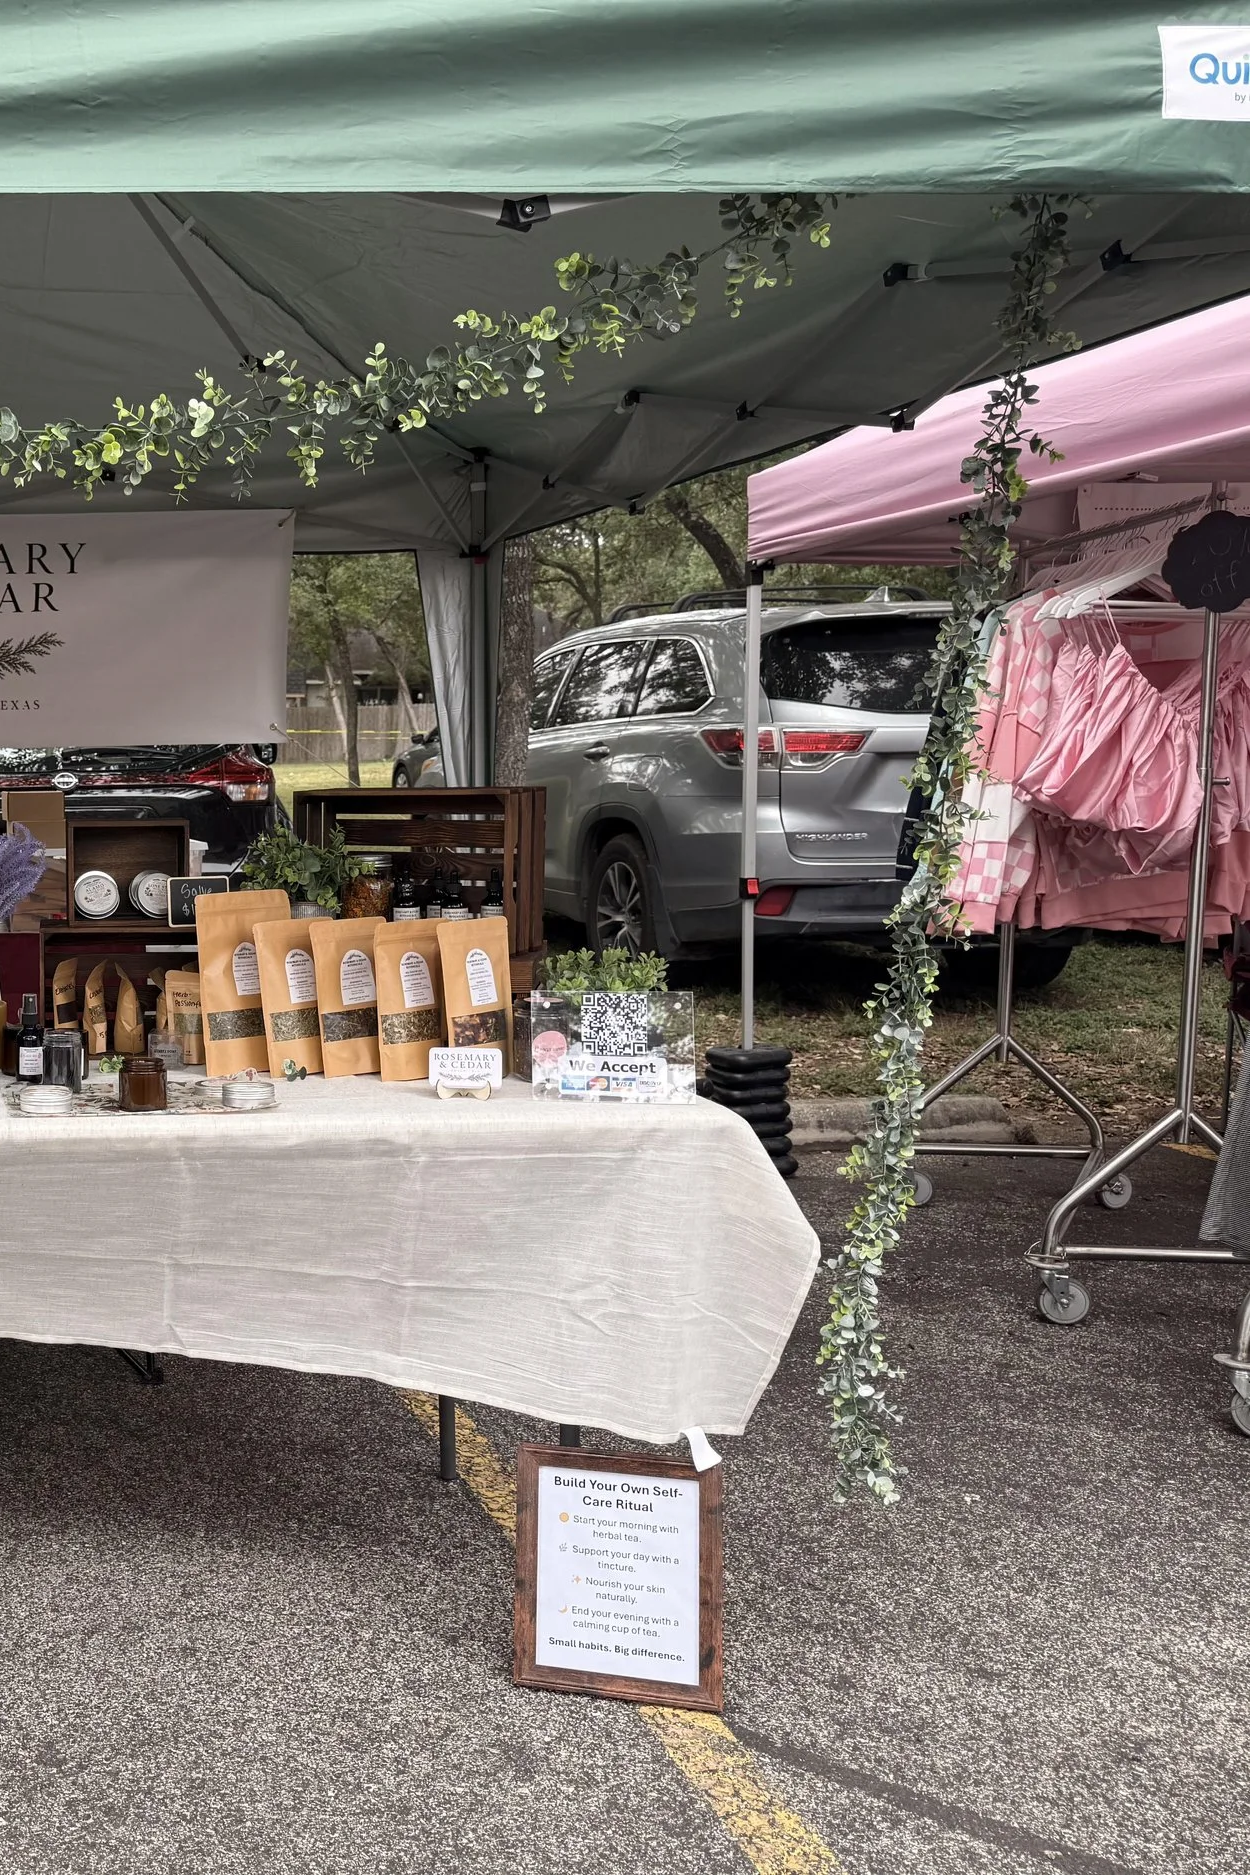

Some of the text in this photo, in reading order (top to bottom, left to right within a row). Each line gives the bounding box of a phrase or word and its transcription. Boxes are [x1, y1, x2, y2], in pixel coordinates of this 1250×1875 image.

[1234, 92, 1247, 104] by
[795, 832, 868, 841] HIGHLANDER
[434, 1053, 496, 1062] ROSEMARY
[451, 1061, 491, 1069] CEDAR
[569, 1060, 656, 1075] We Accept
[554, 1475, 683, 1498] Build Your Own Self-
[582, 1495, 653, 1512] Care Ritual
[573, 1515, 679, 1534] Start your morning with
[593, 1530, 642, 1543] herbal tea.
[572, 1545, 609, 1556] Support
[610, 1550, 631, 1559] your
[633, 1553, 650, 1563] day
[651, 1555, 671, 1564] with
[598, 1561, 636, 1573] tincture.
[585, 1577, 665, 1594] Nourish your skin
[595, 1591, 638, 1605] naturally.
[571, 1605, 680, 1627] End your evening with a
[572, 1620, 661, 1638] calming cup of tea.
[548, 1637, 685, 1662] Small habits. Big difference.
